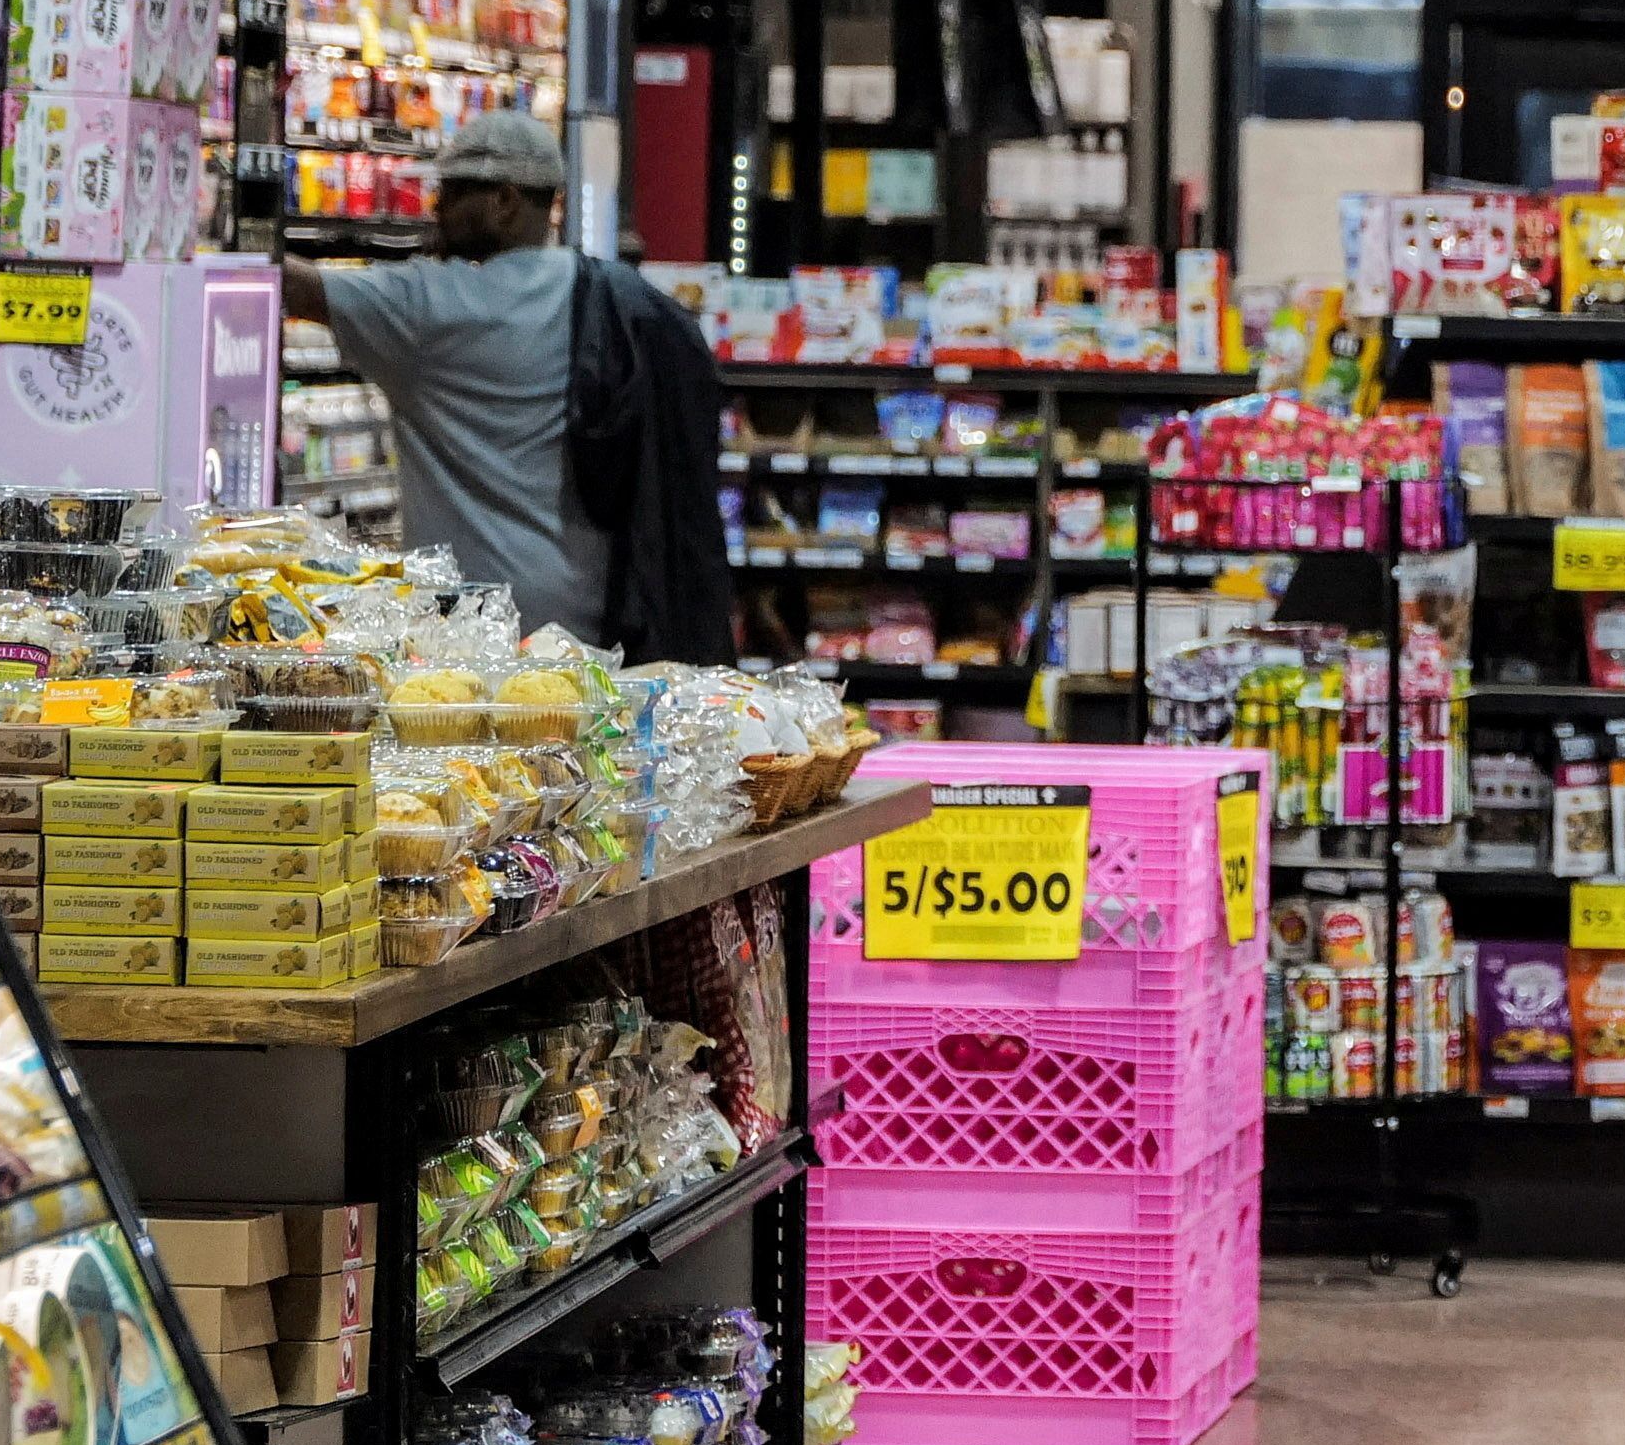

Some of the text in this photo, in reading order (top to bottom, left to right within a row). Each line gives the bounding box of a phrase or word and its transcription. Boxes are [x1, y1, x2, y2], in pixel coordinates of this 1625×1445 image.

[83, 155, 98, 201] POP
[0, 300, 82, 322] $7.99
[18, 365, 127, 426] GUT HEALTH
[78, 742, 145, 752] OLD FASHIONED
[232, 748, 301, 757] OLD FASHIONED
[983, 786, 1040, 805] SPECIAL
[51, 800, 121, 810] OLD FASHIONED
[197, 806, 266, 817] OLD FASHIONED
[54, 850, 123, 860] OLD FASHIONED
[195, 855, 263, 865] OLD FASHIONED
[883, 865, 1072, 920] 5/$5.00
[53, 899, 122, 909] OLD FASHIONED
[193, 902, 260, 912] OLD FASHIONED
[49, 948, 117, 958] OLD FASHIONED
[197, 951, 266, 962] OLD FASHIONED
